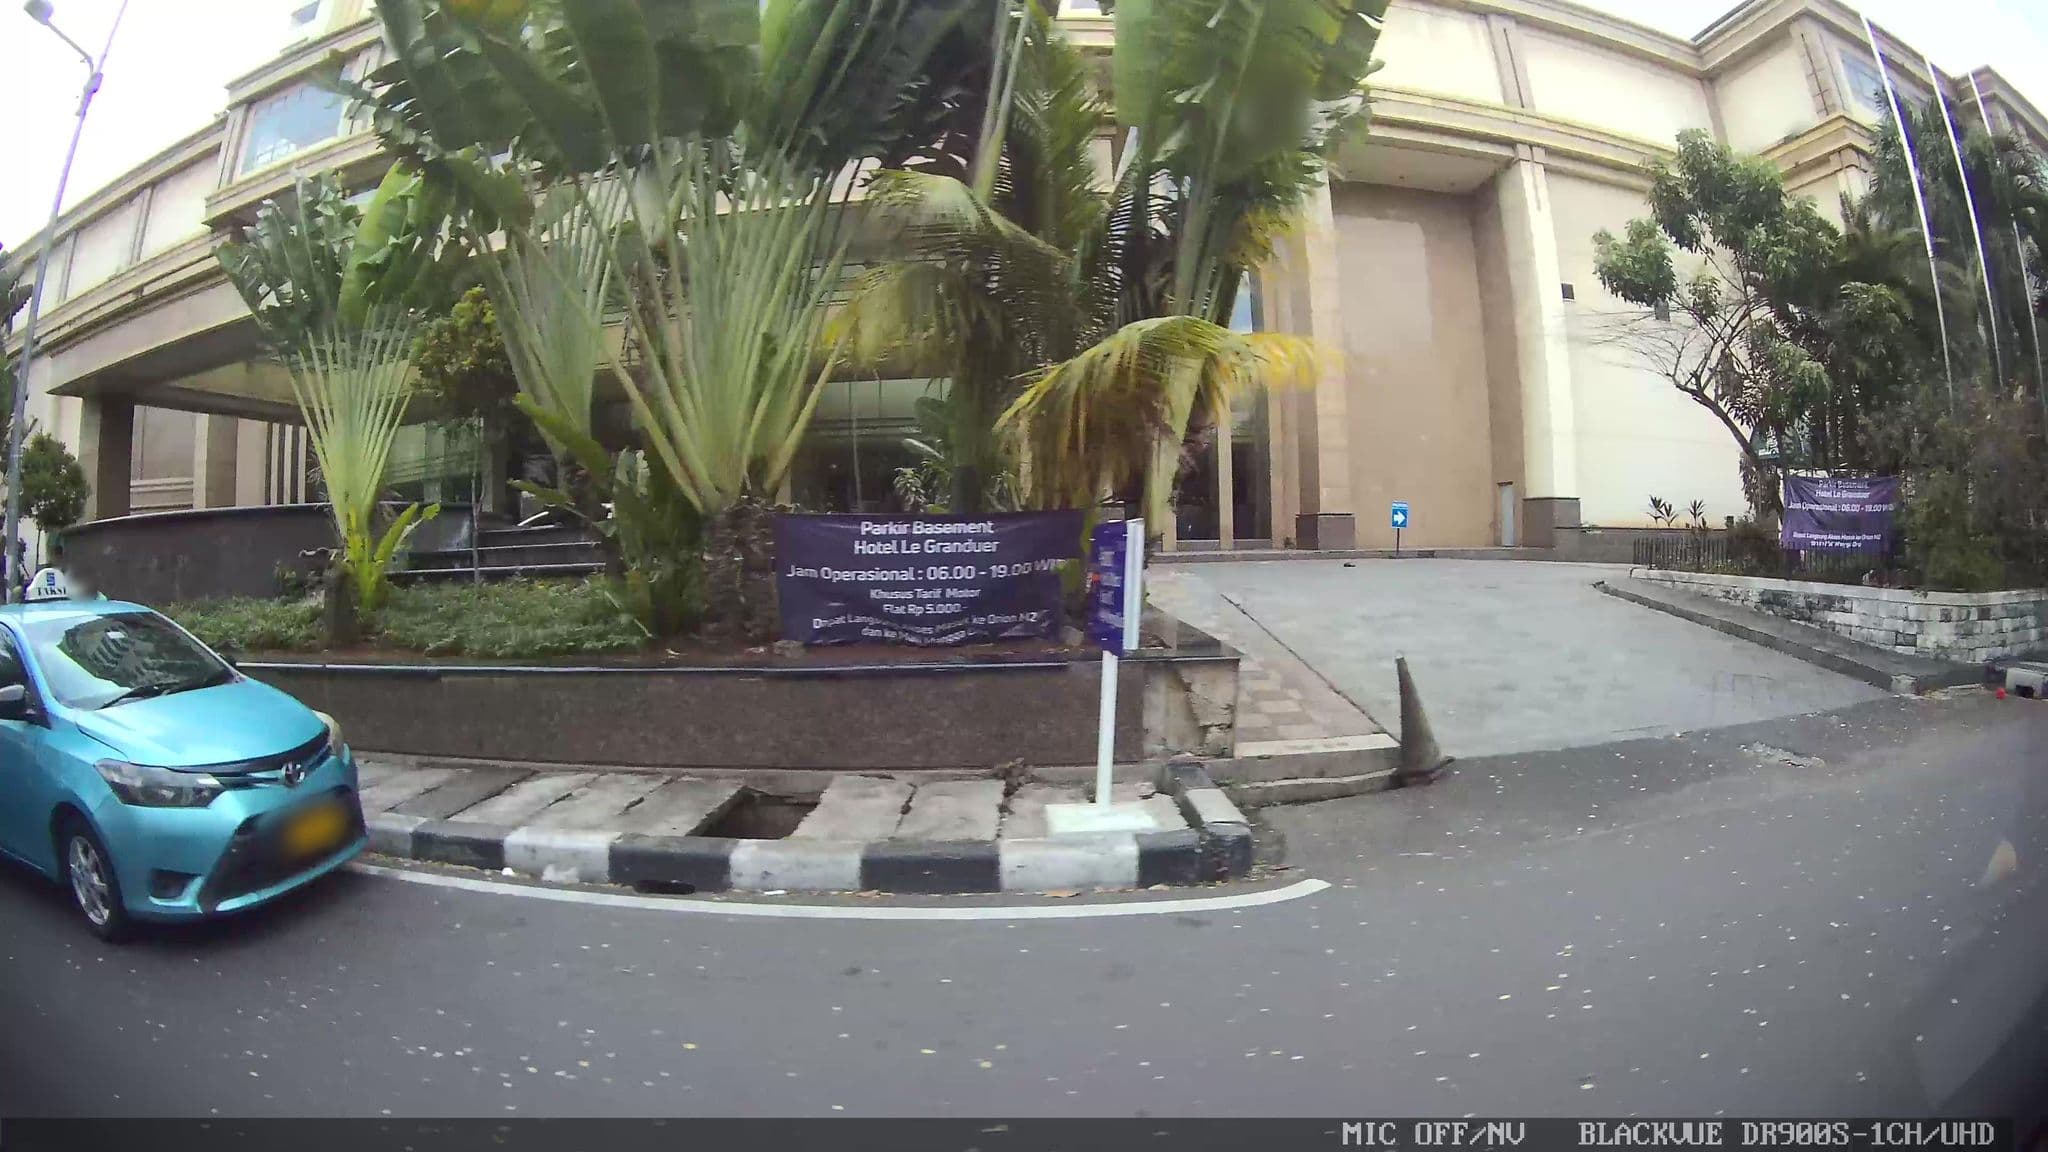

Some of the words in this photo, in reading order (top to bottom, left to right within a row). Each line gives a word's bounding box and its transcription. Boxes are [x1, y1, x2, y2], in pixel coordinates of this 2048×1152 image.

[861, 521, 910, 535] Parkir
[912, 520, 994, 535] Basement
[854, 539, 899, 554] Hotel
[901, 540, 921, 554] Le
[923, 539, 1000, 554] Granduer
[786, 564, 818, 578] Jam
[820, 566, 915, 583] Operasional
[926, 566, 976, 581] 06.00
[989, 562, 1032, 578] 19.00
[870, 588, 913, 599] Khusus
[914, 588, 942, 599] Tarif
[944, 587, 981, 598] Motor
[883, 603, 906, 614] Flat
[907, 603, 924, 616] Rp
[861, 626, 882, 637] dan
